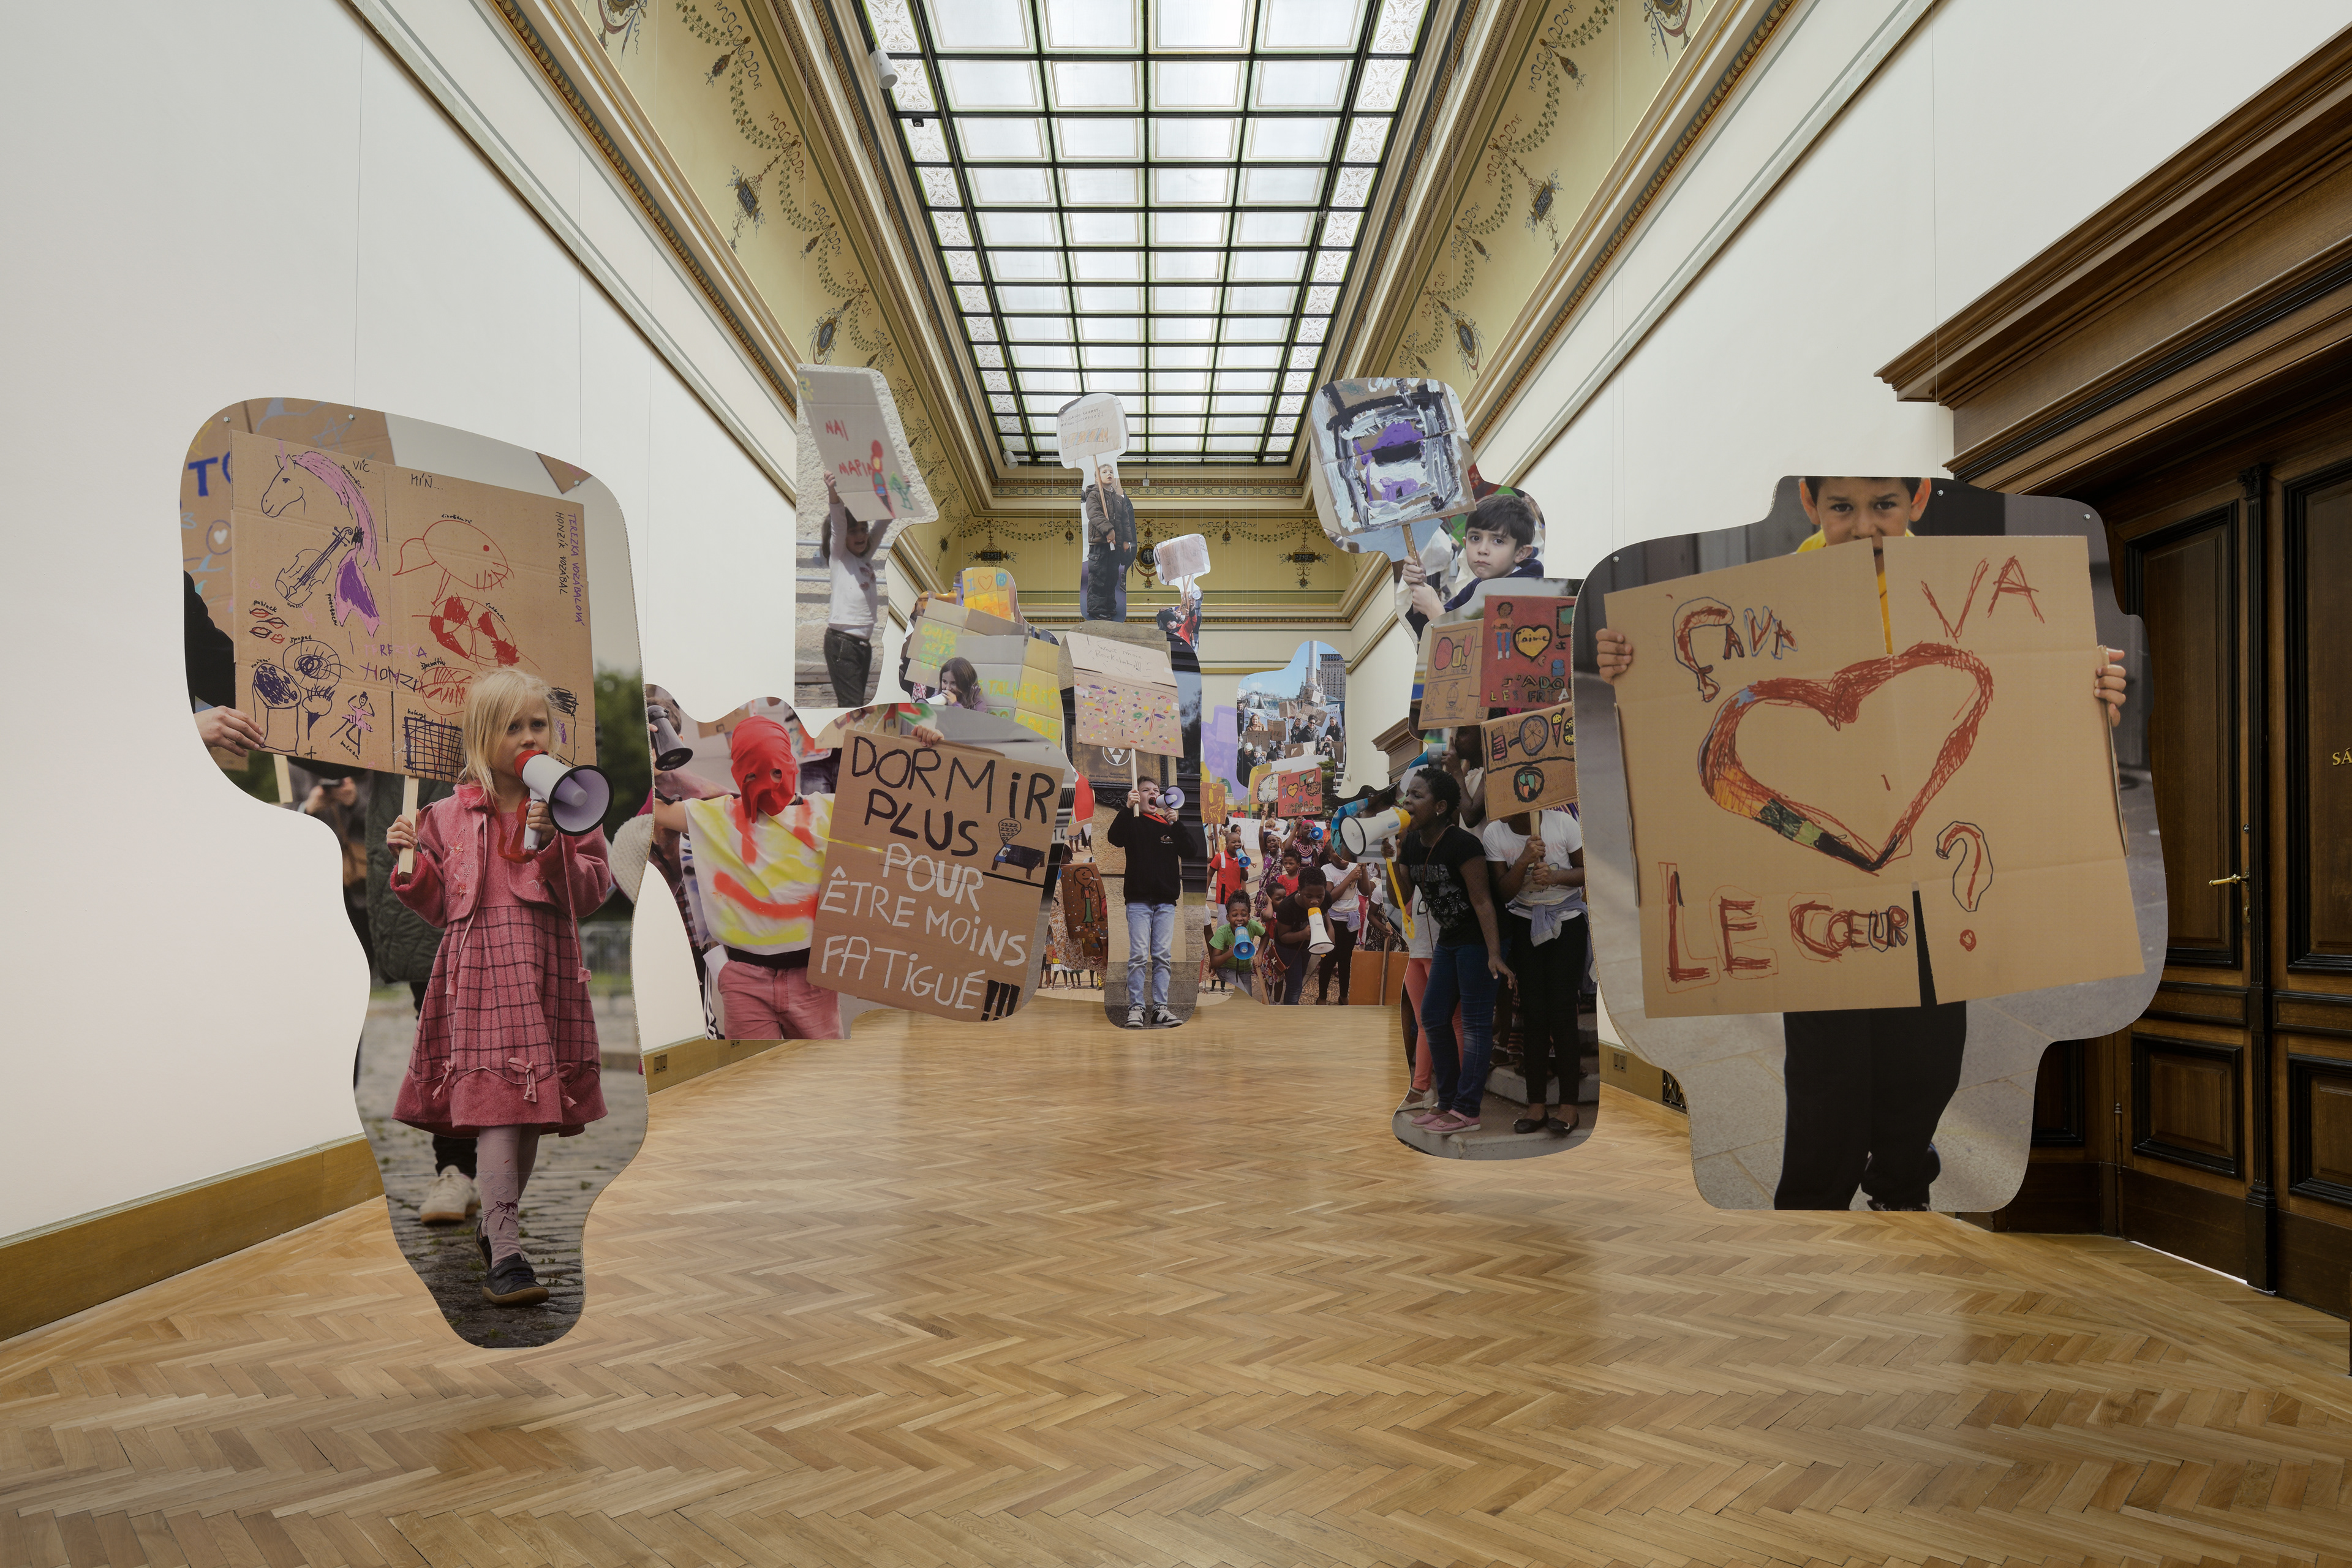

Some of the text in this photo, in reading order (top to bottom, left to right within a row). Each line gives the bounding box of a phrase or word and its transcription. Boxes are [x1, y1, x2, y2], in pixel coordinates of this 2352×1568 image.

[567, 513, 579, 557] TEREZKA
[1921, 555, 2045, 643] VA
[1491, 690, 1520, 702] LES
[1502, 675, 1572, 689] J'ADO
[864, 788, 979, 857] PLUS
[820, 865, 916, 928] ÊTRE
[883, 843, 984, 911] POUR
[1657, 861, 1779, 993] LE
